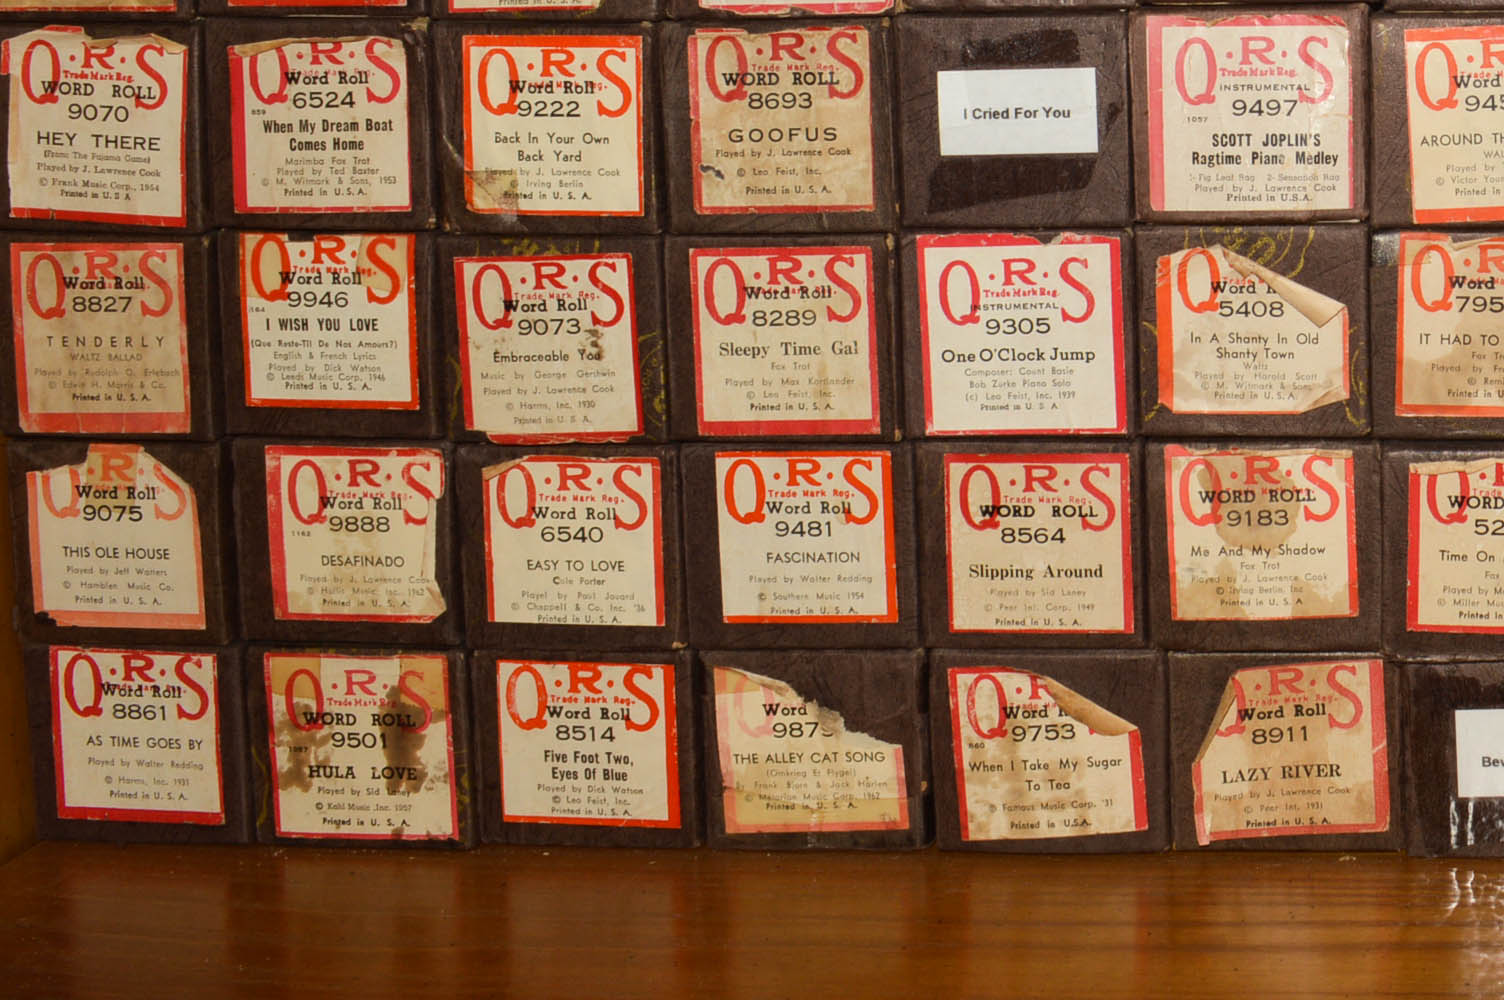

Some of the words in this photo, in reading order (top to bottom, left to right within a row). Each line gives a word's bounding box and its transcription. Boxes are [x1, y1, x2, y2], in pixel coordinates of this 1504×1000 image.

[293, 91, 355, 109] 6524
[748, 92, 812, 109] 8693
[1232, 100, 1297, 116] 9497
[69, 104, 129, 122] 9070
[973, 108, 1009, 119] Cried
[1015, 108, 1038, 119] For
[1042, 107, 1070, 118] You
[38, 131, 76, 146] HEY
[91, 134, 160, 151] THERE
[728, 127, 837, 143] GOOFUS
[73, 296, 132, 312] 8827
[288, 291, 348, 308] 9946
[518, 318, 581, 335] 9073
[752, 310, 816, 327] 8289
[986, 318, 1050, 335] 9305
[47, 336, 163, 347] TENDERLY
[83, 504, 142, 522] 9075
[329, 516, 390, 532] 9888
[775, 521, 831, 537] 9481
[541, 526, 603, 543] 6540
[1001, 528, 1066, 543] 8564
[321, 555, 404, 567] DESAFINADO
[767, 552, 860, 563] FASCINATION
[113, 704, 165, 720] 8861
[556, 725, 615, 742] 8514
[1252, 726, 1307, 744] 8911
